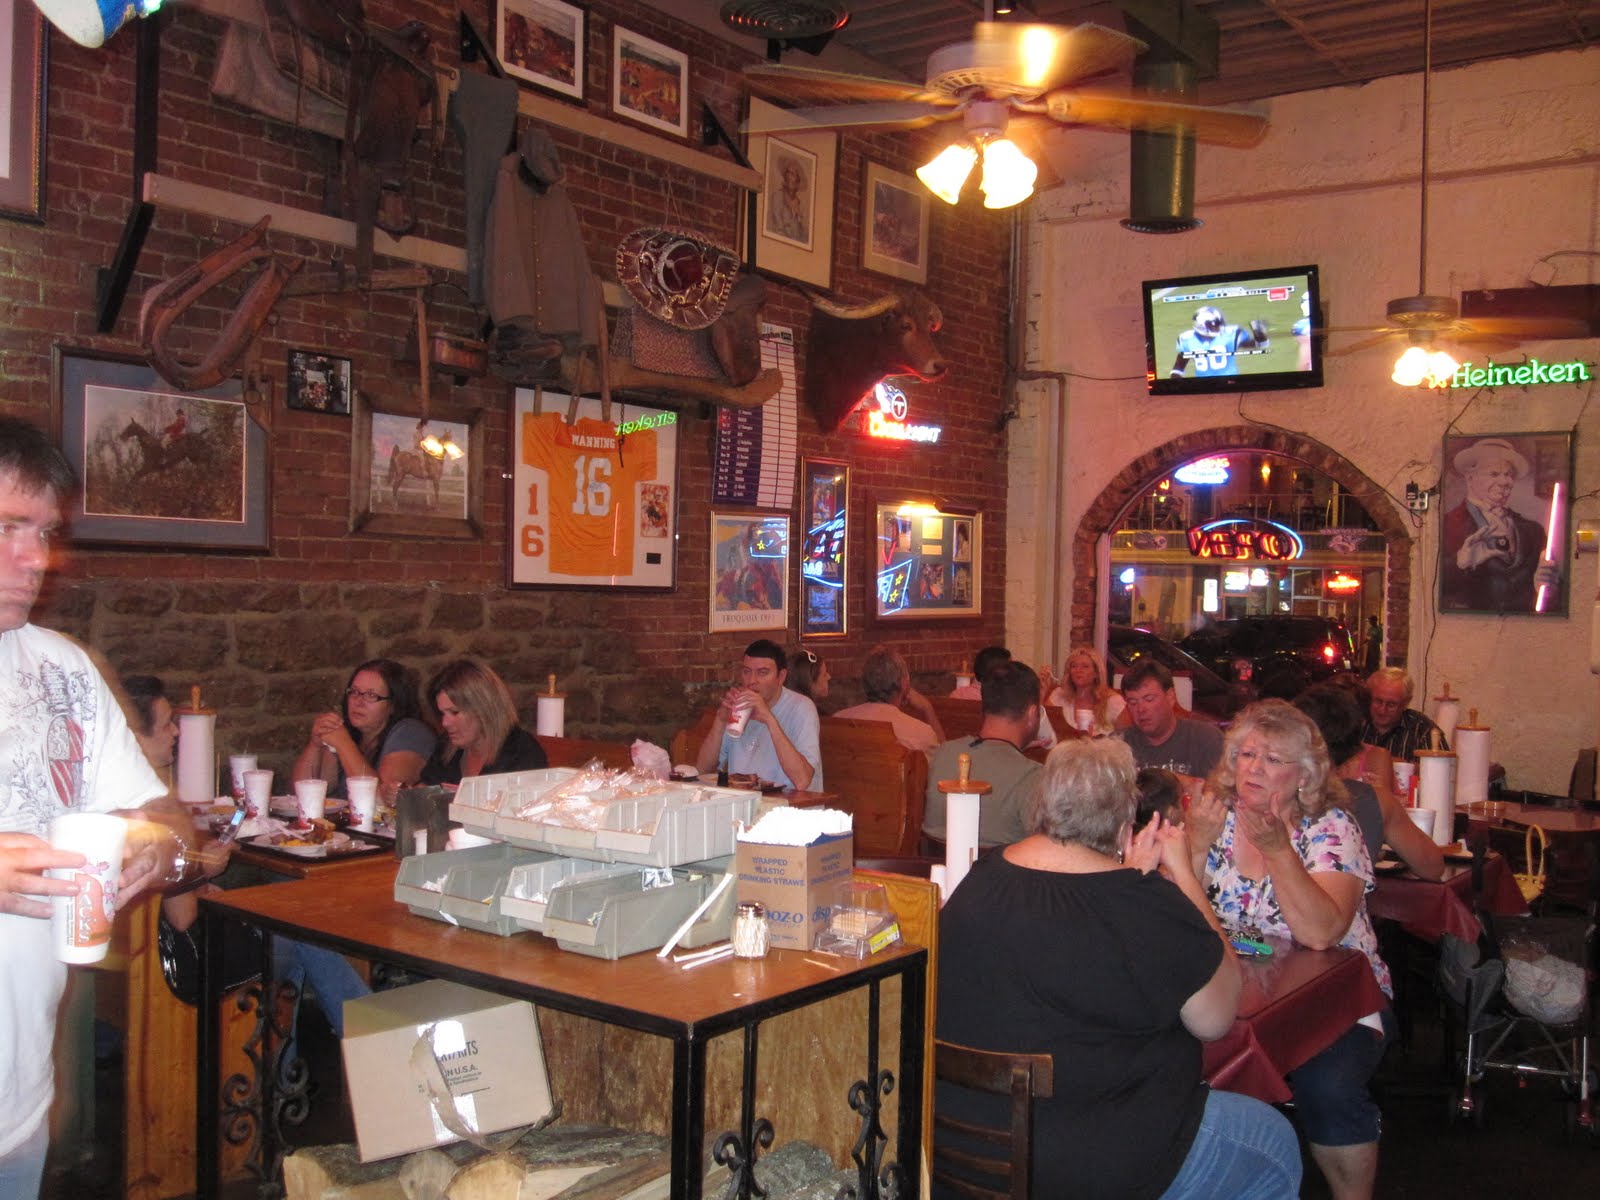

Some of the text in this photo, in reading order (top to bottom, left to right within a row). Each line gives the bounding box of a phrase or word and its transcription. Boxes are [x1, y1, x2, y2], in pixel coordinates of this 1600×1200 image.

[1450, 359, 1590, 389] Heineken
[571, 434, 616, 449] MANNING
[572, 454, 612, 517] 16
[752, 856, 788, 866] WRAPPED
[738, 873, 806, 887] DRINKING STRAWS
